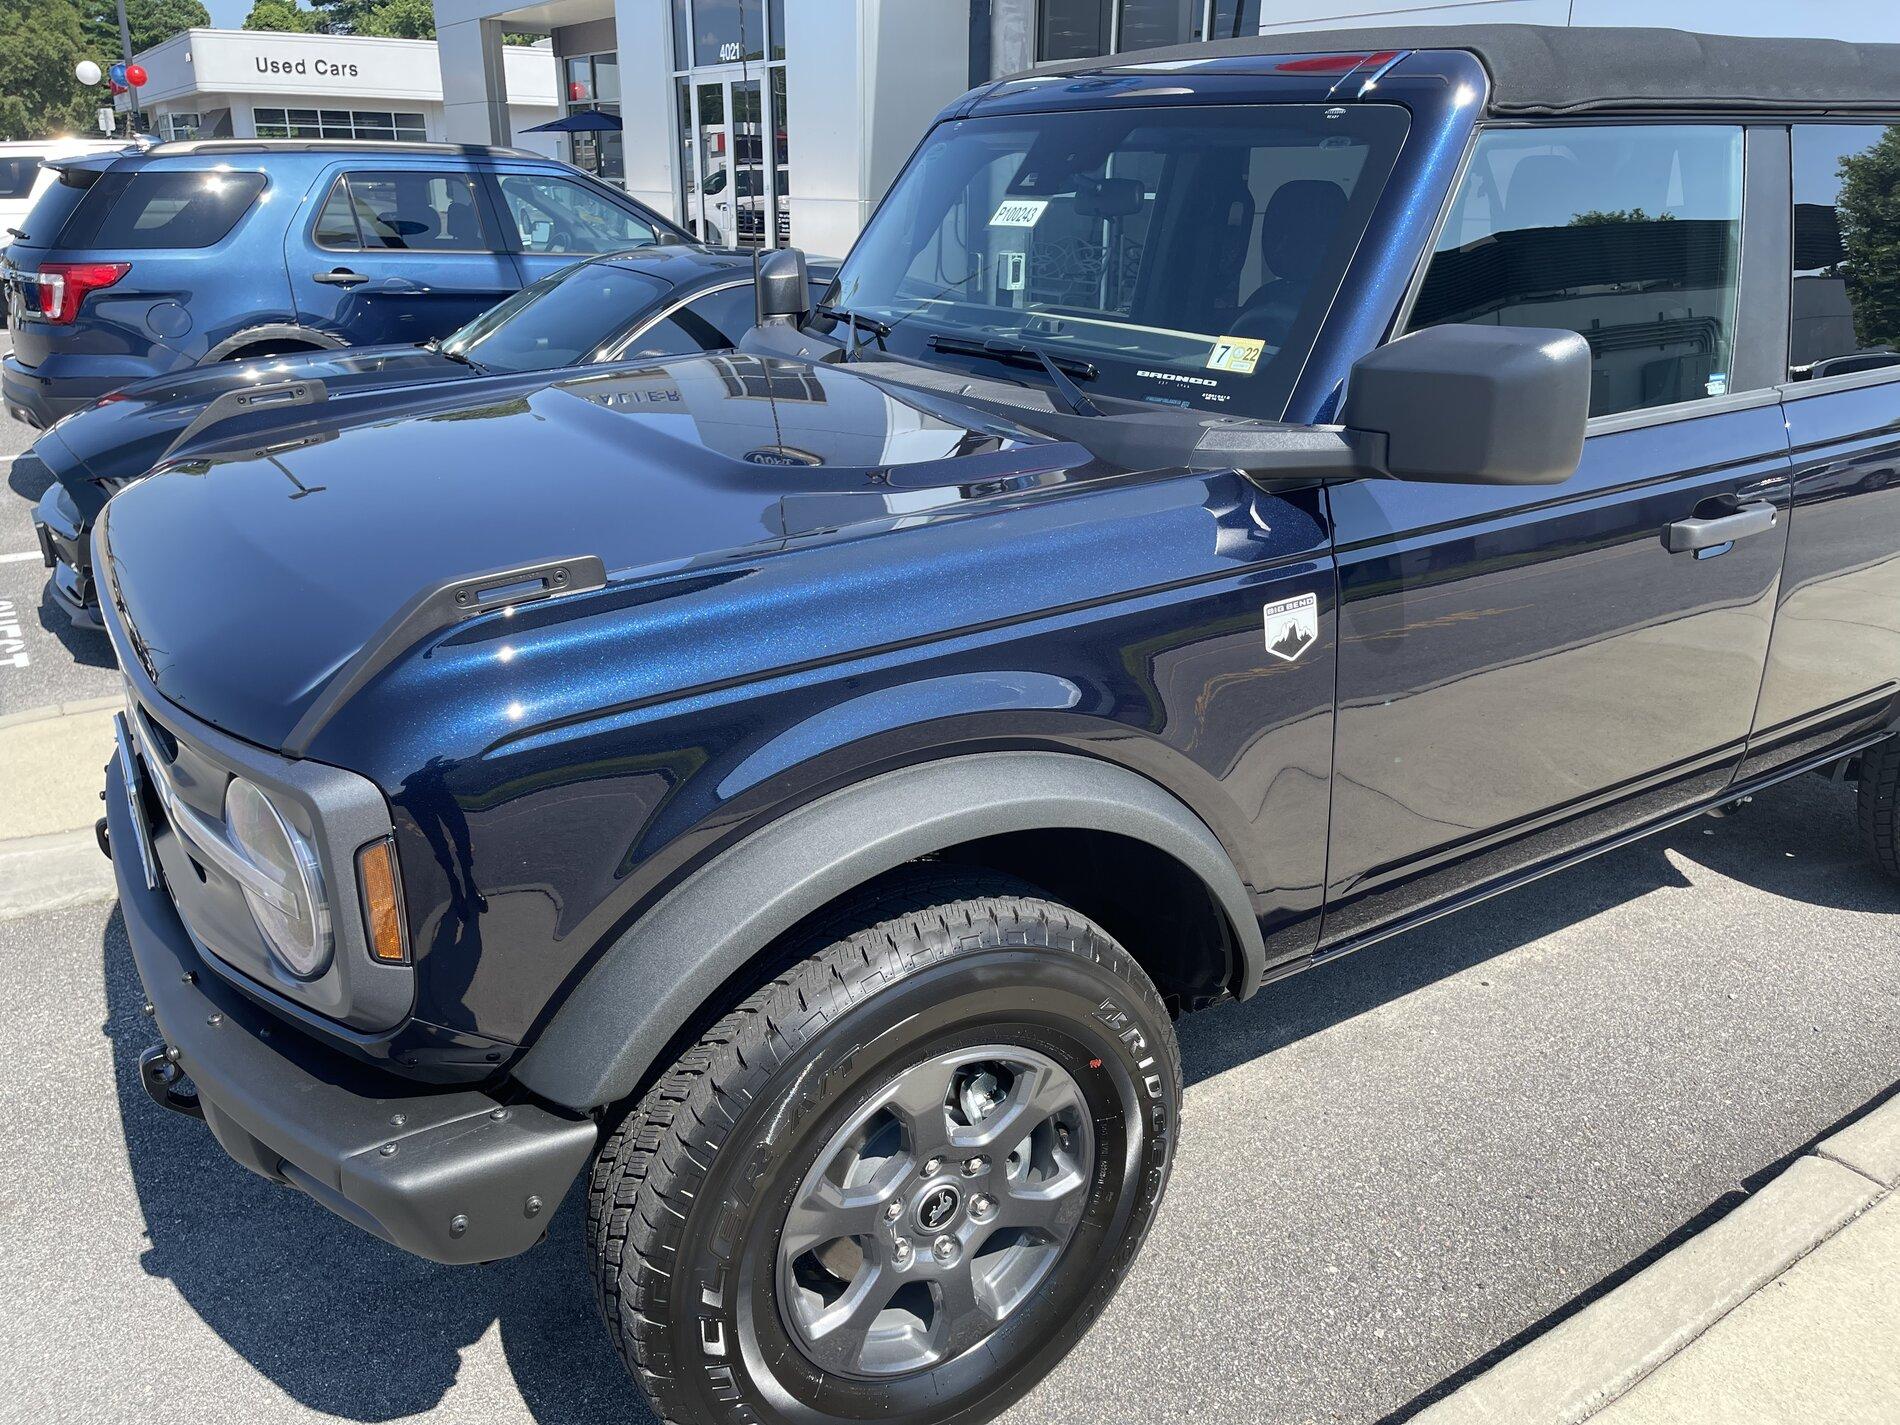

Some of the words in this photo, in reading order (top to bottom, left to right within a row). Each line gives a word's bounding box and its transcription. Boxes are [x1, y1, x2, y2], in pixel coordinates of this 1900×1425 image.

[720, 42, 740, 60] 4021
[256, 57, 306, 74] Used
[315, 59, 358, 76] Cars
[994, 206, 1038, 222] P100243
[1217, 345, 1231, 363] 7
[1243, 347, 1259, 361] 22
[1136, 370, 1217, 387] BRONCO
[1267, 605, 1285, 616] BIG
[1286, 597, 1314, 611] BEND
